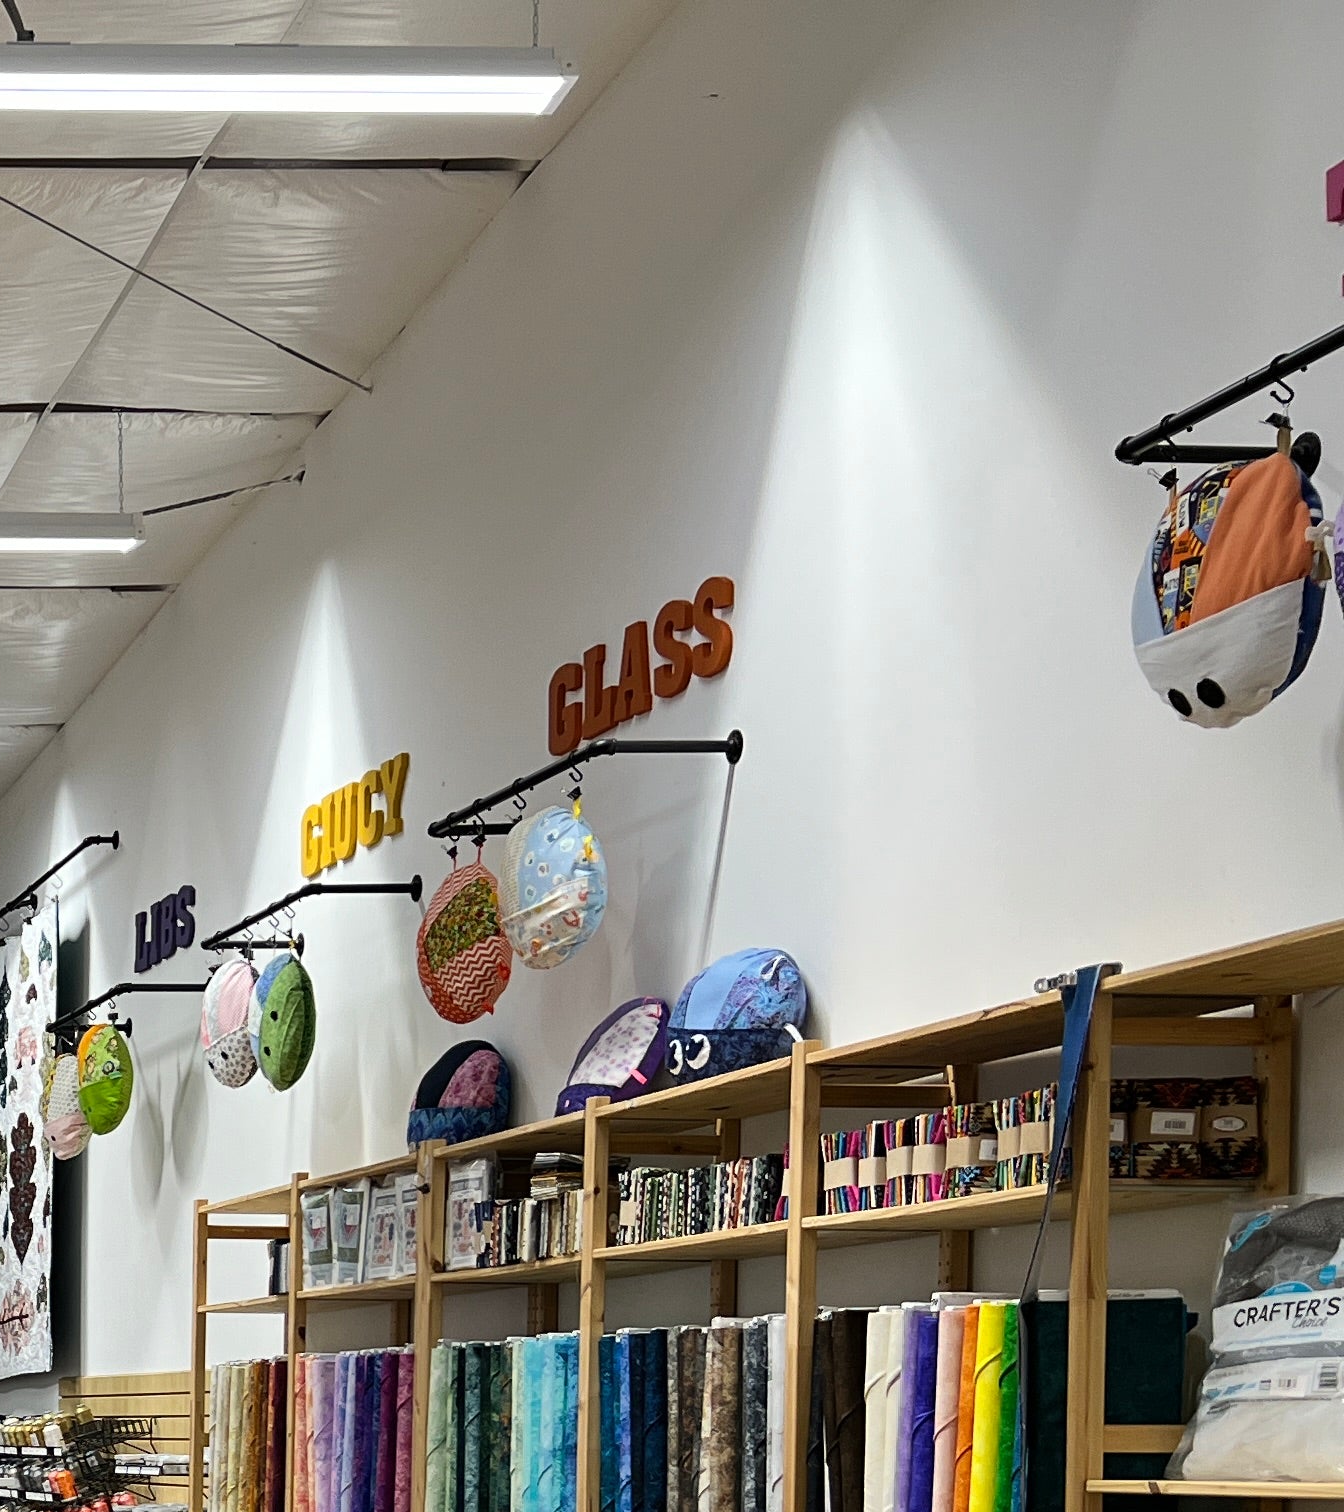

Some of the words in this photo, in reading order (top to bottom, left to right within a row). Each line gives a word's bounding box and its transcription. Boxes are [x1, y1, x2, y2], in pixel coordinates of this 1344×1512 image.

[548, 576, 735, 756] GLASS
[301, 752, 410, 879] GIUCY
[134, 886, 196, 973] LIBS
[1233, 1296, 1342, 1328] CRAFTER'S
[1292, 1315, 1329, 1329] Choice
